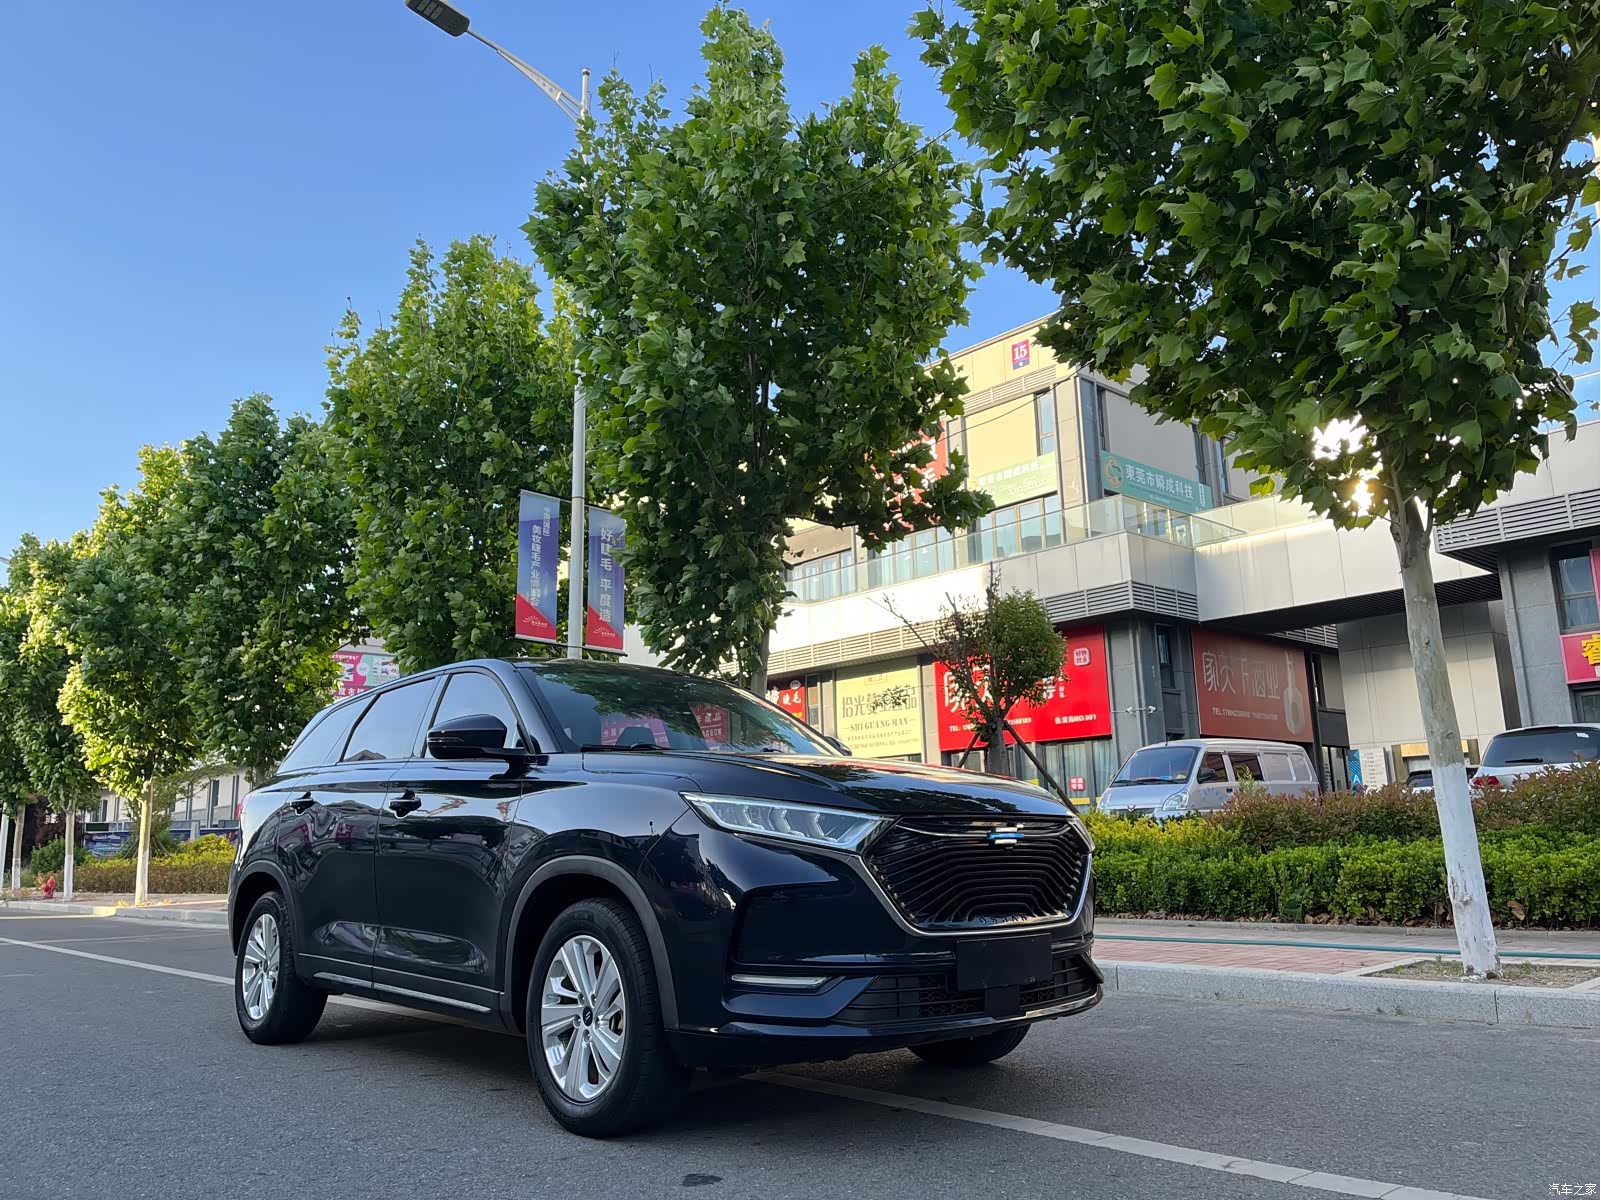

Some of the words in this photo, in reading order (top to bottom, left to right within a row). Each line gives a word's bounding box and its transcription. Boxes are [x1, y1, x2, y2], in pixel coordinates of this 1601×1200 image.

[1014, 344, 1028, 360] 15
[864, 719, 891, 730] GUANG
[891, 717, 909, 727] MAN
